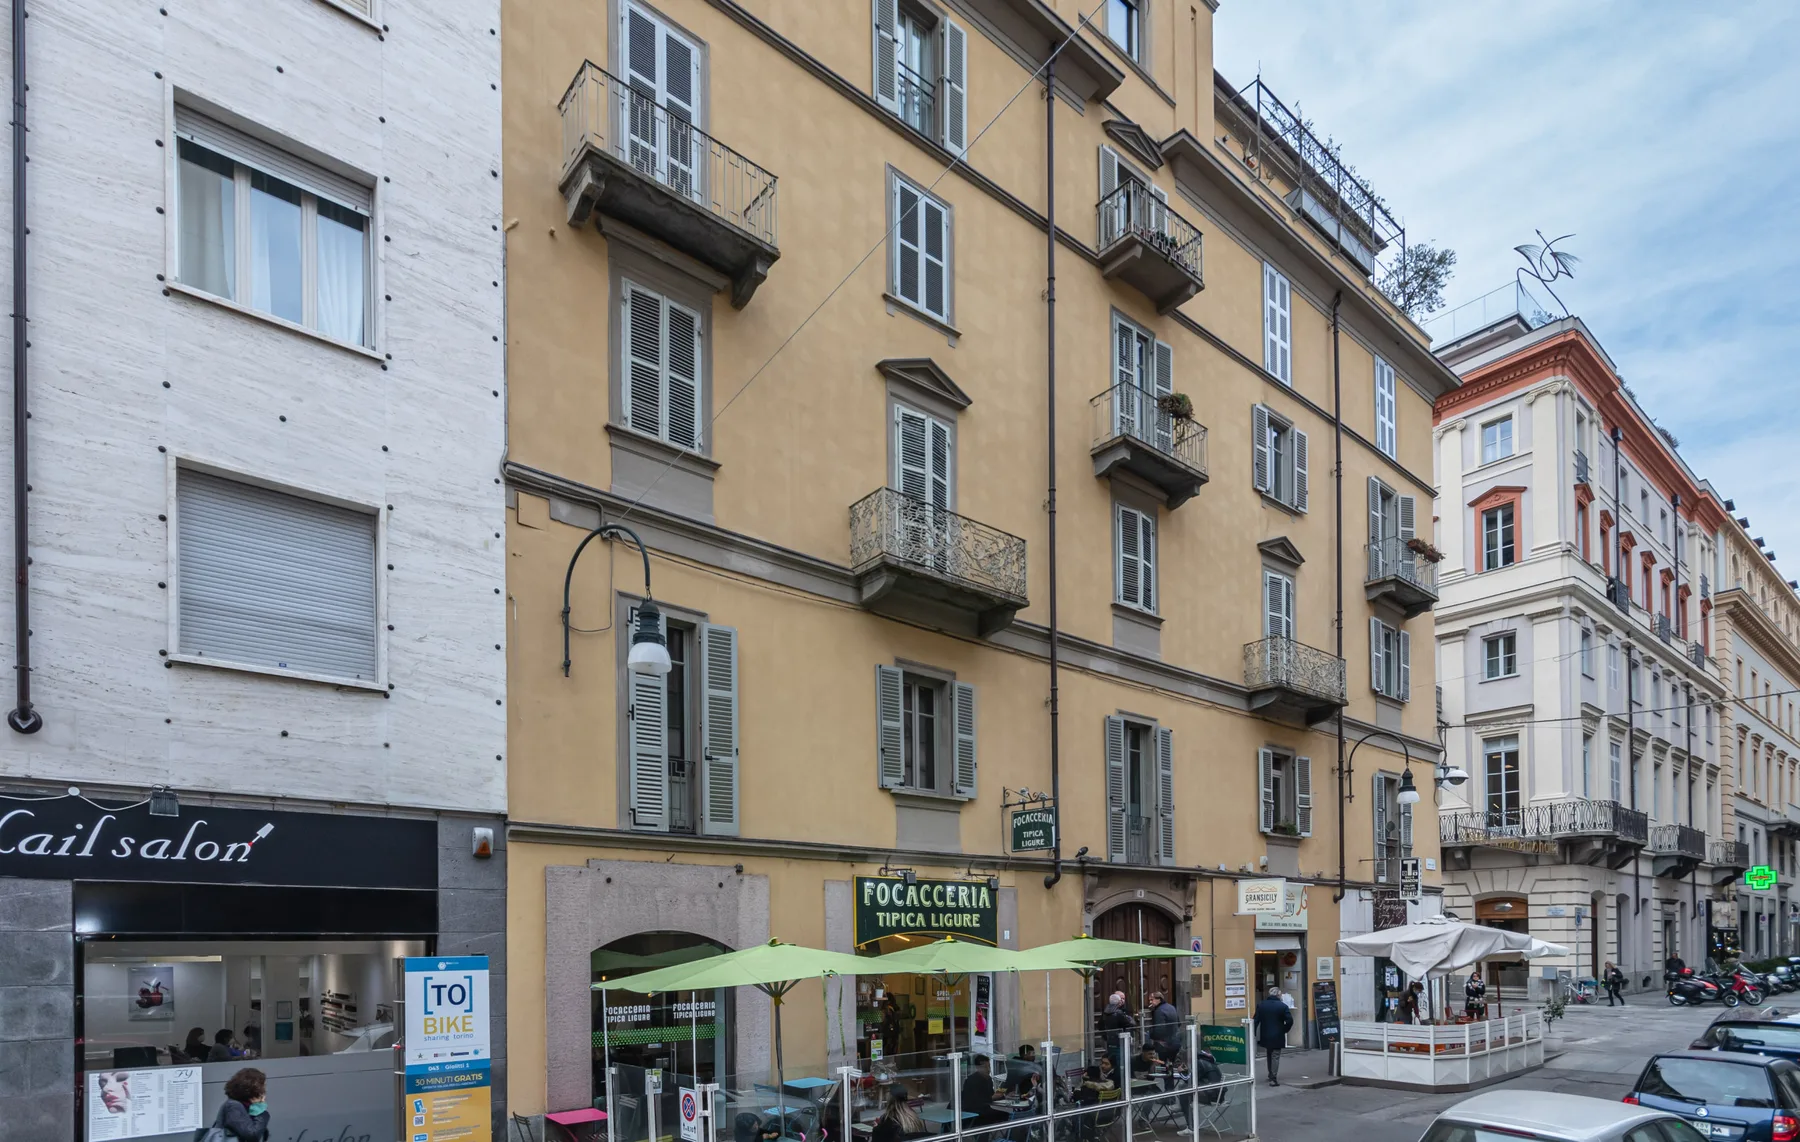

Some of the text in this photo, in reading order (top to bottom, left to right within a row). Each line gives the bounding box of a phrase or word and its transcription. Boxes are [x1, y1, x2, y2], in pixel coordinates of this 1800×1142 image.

[1013, 812, 1054, 829] FOCACCERIA
[111, 820, 252, 862] salon
[1022, 829, 1044, 838] TIPICA
[1021, 838, 1045, 847] LIGURE
[863, 881, 991, 908] FOCACCERIA
[1245, 893, 1277, 904] GRANSICILY
[876, 912, 980, 928] TIPICA LIGURE
[424, 1015, 473, 1034] BIKE
[415, 1079, 425, 1087] 30
[426, 1076, 453, 1085] MINUTI
[454, 1073, 483, 1082] GRATIS
